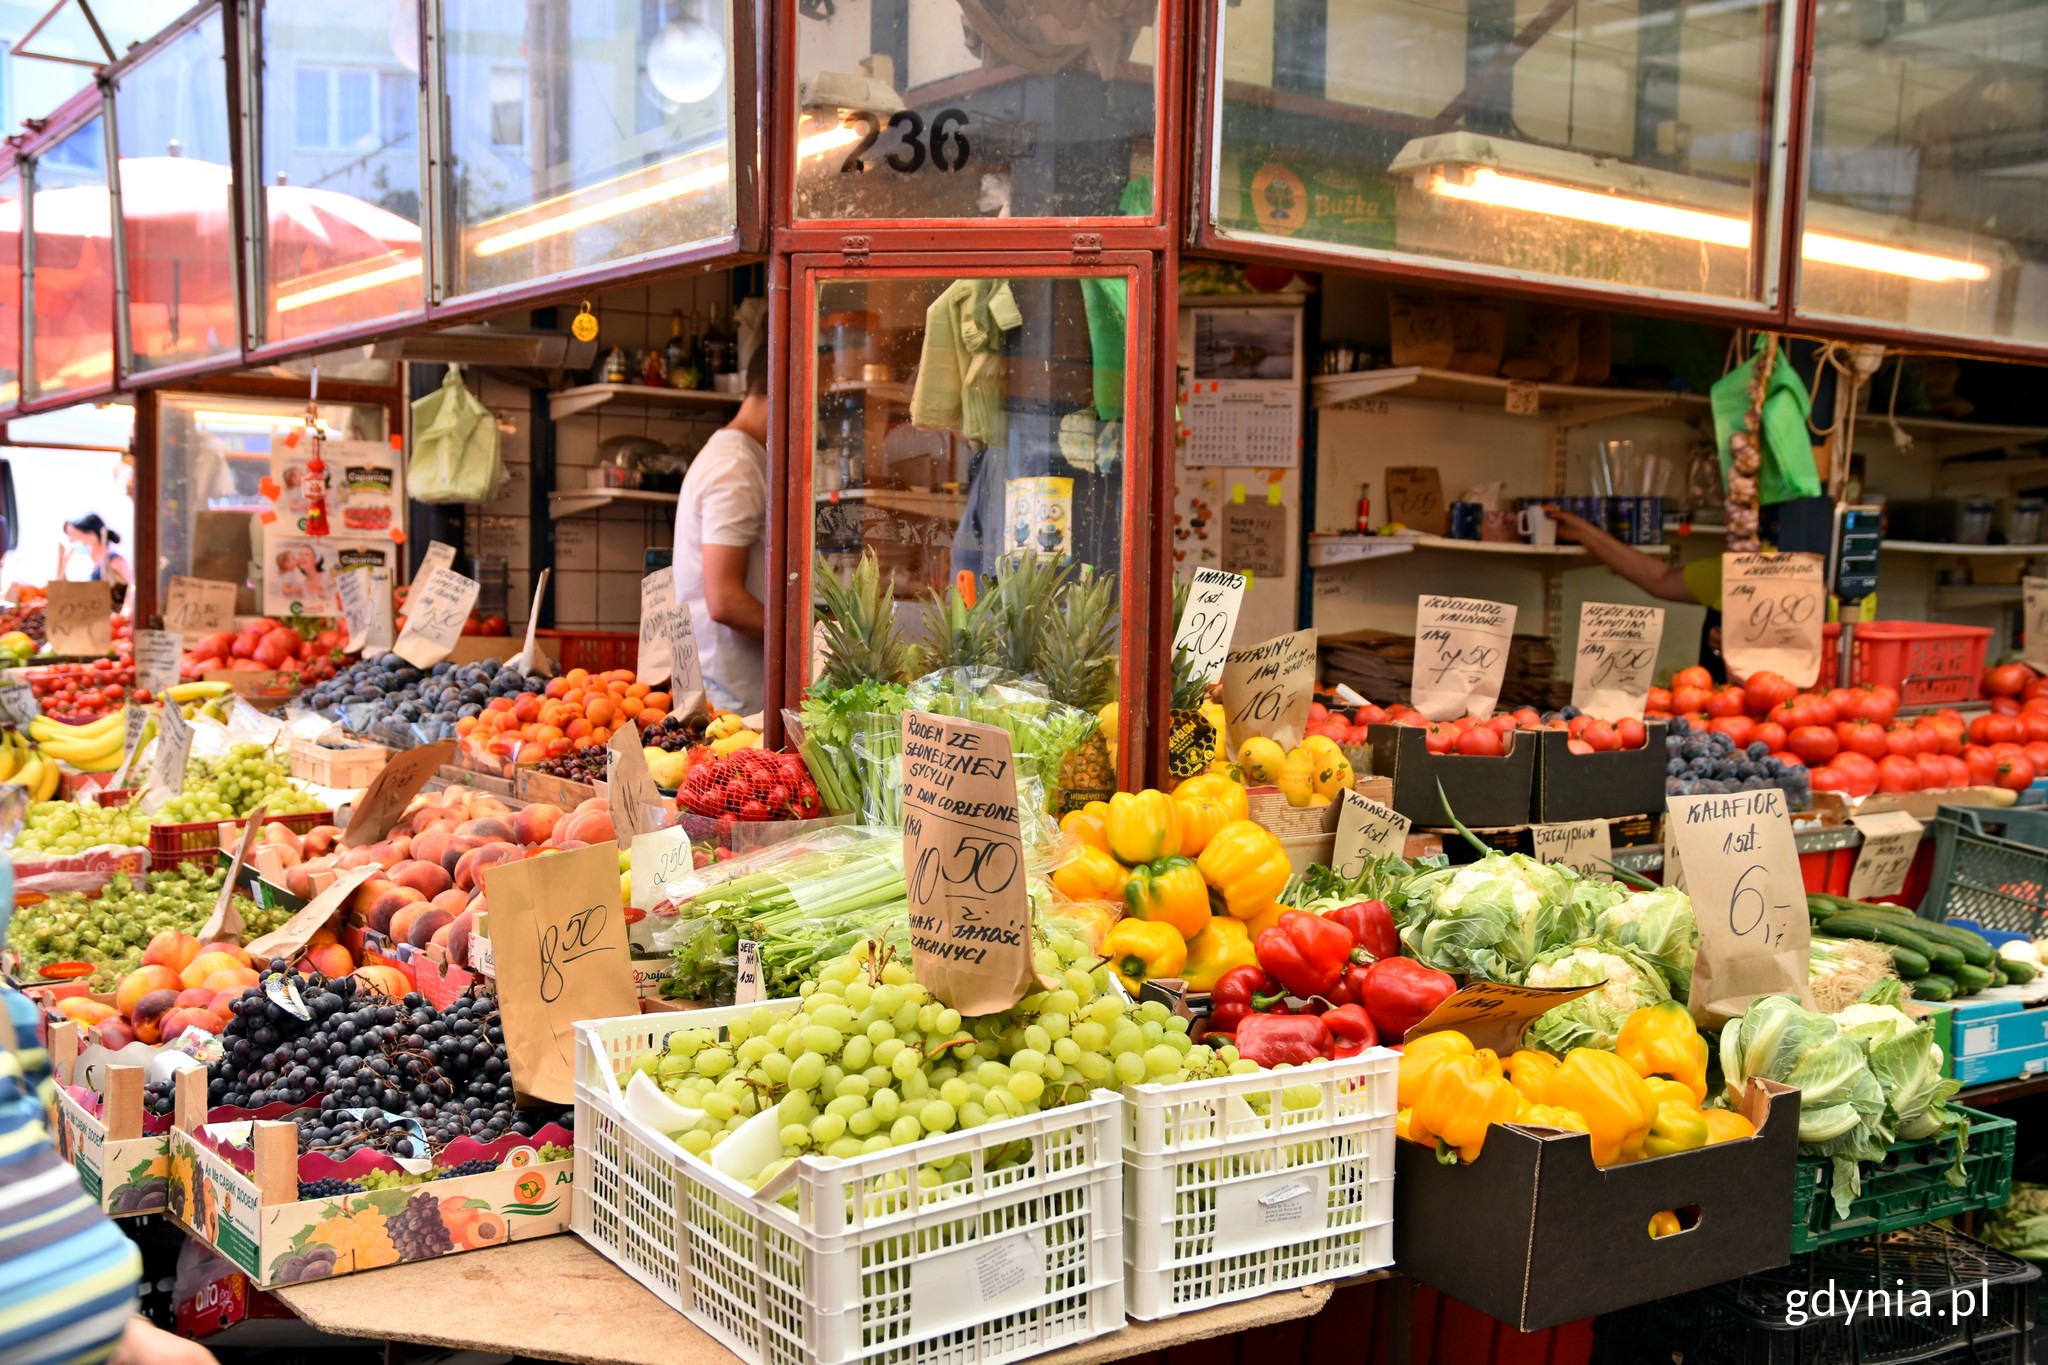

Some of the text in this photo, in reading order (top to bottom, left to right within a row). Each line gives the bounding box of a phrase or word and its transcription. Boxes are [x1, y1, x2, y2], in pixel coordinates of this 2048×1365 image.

[841, 108, 970, 174] 236
[1194, 571, 1244, 589] ANANAS
[1226, 636, 1295, 663] CYTRYNY
[946, 732, 981, 750] ZE
[905, 742, 1007, 780] SŁONECZNEJ
[917, 787, 937, 805] DON
[938, 796, 1018, 823] CORLEONE
[1348, 794, 1406, 831] KALAREPA
[1686, 792, 1783, 824] KALAFIOR
[952, 920, 1025, 946] JAKOŚĆ
[911, 934, 987, 964] ZACHWYCI
